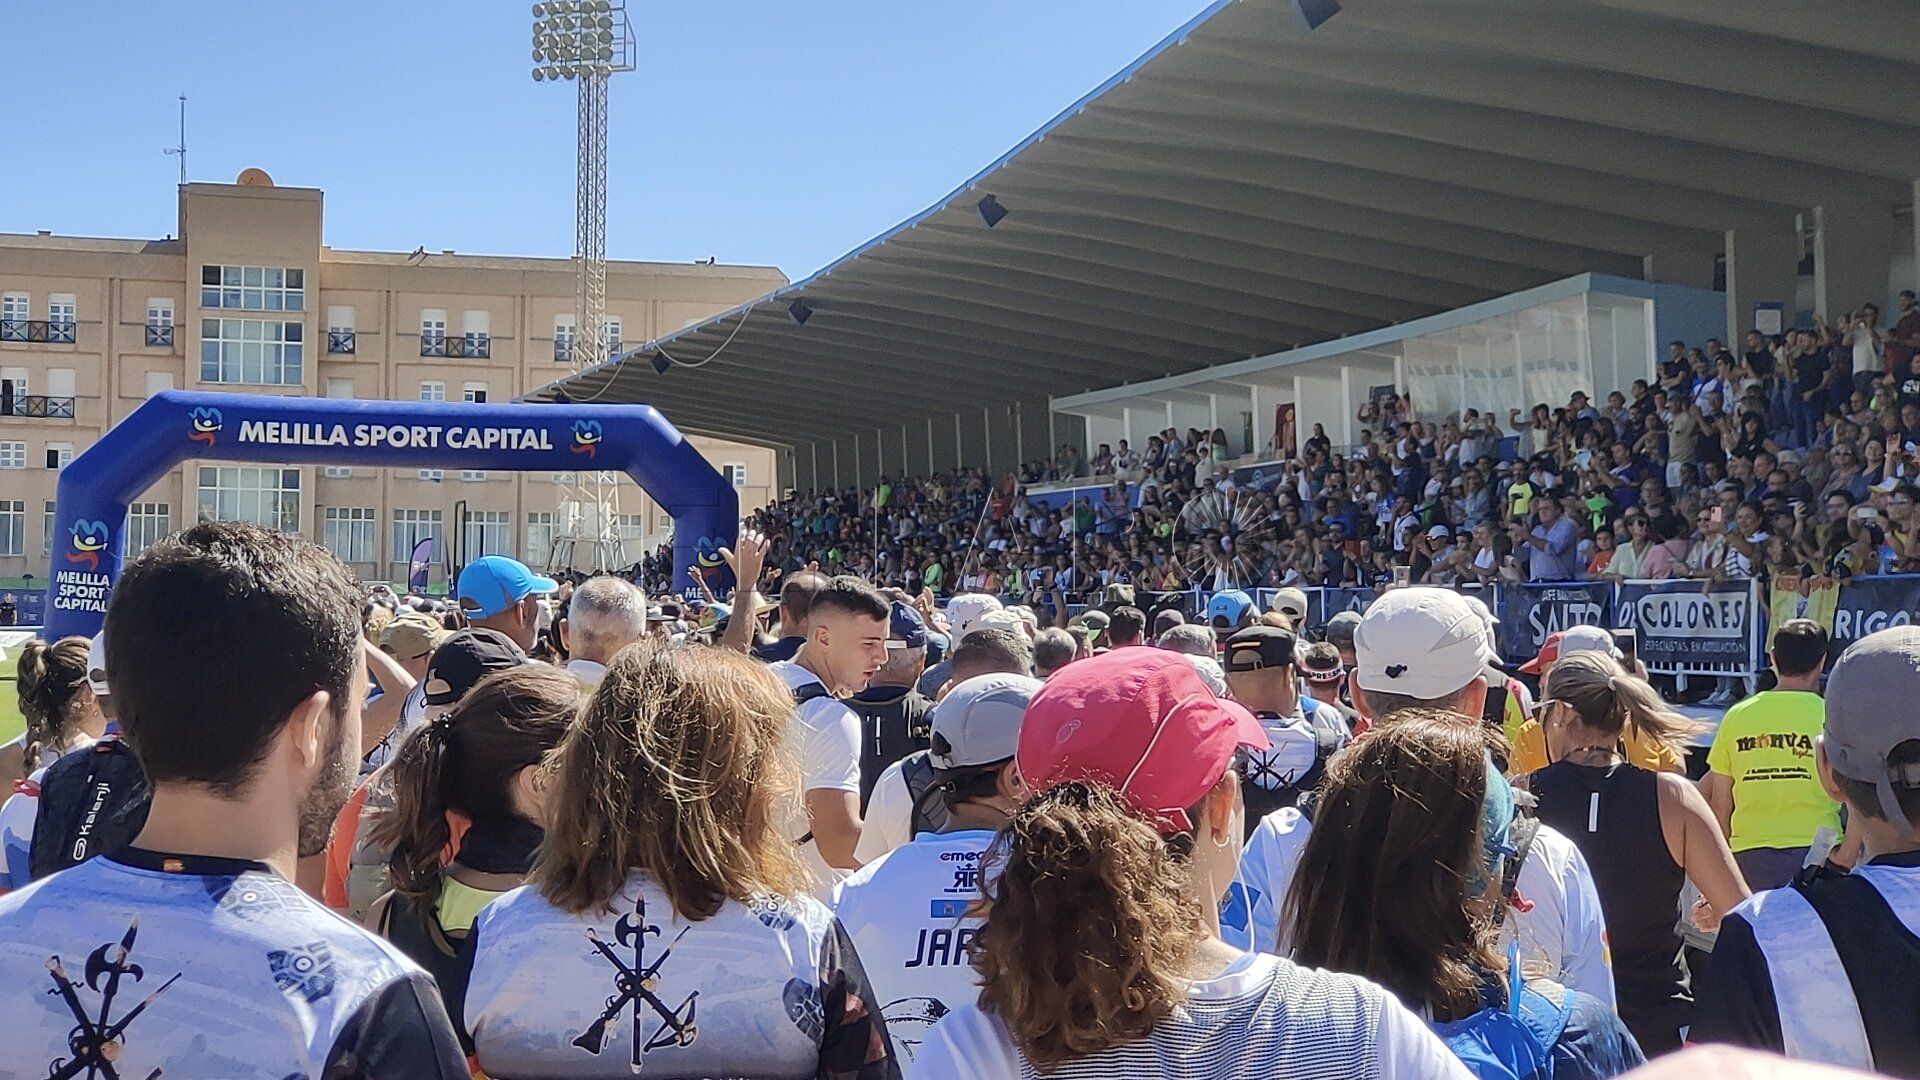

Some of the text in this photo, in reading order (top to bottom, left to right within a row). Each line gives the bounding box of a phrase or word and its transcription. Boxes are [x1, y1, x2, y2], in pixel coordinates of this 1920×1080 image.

[238, 420, 553, 450] MELILLA SPORT CAPITAL
[56, 571, 110, 587] MELILLA
[59, 584, 105, 599] SPORT
[54, 597, 107, 612] CAPITAL
[1642, 600, 1743, 629] COLORES
